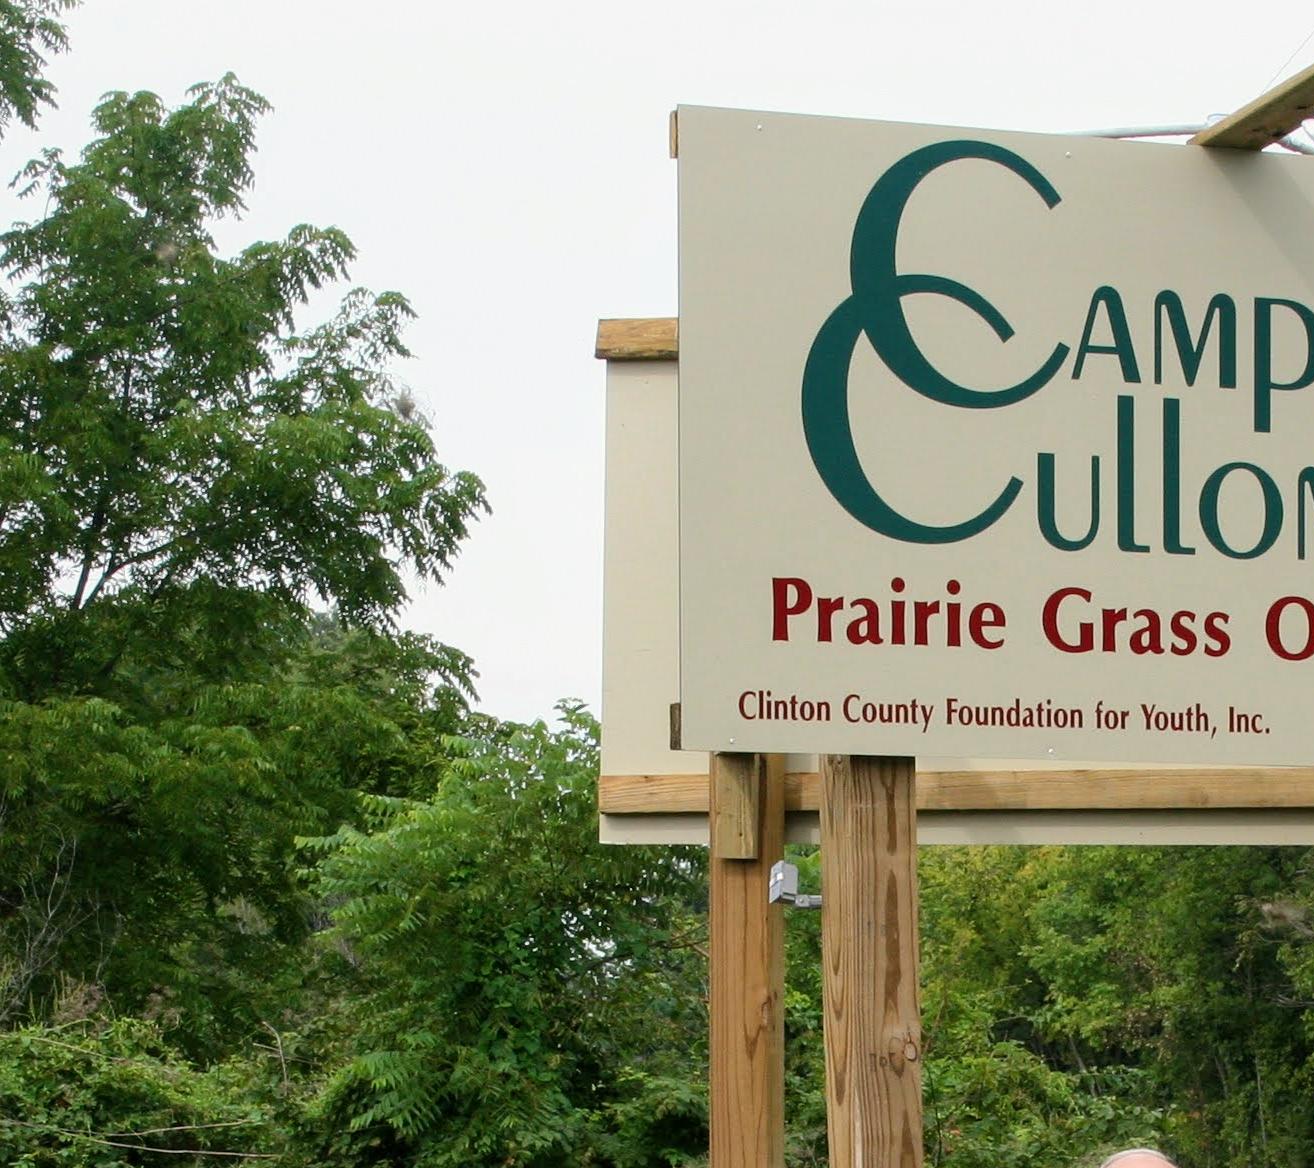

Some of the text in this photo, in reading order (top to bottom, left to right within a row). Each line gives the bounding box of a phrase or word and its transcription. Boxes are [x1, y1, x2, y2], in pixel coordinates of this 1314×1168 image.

[771, 576, 1006, 650] Prairie
[1042, 587, 1232, 658] Grass
[738, 691, 1272, 738] Clinton County Foundation for Youth, Inc.
